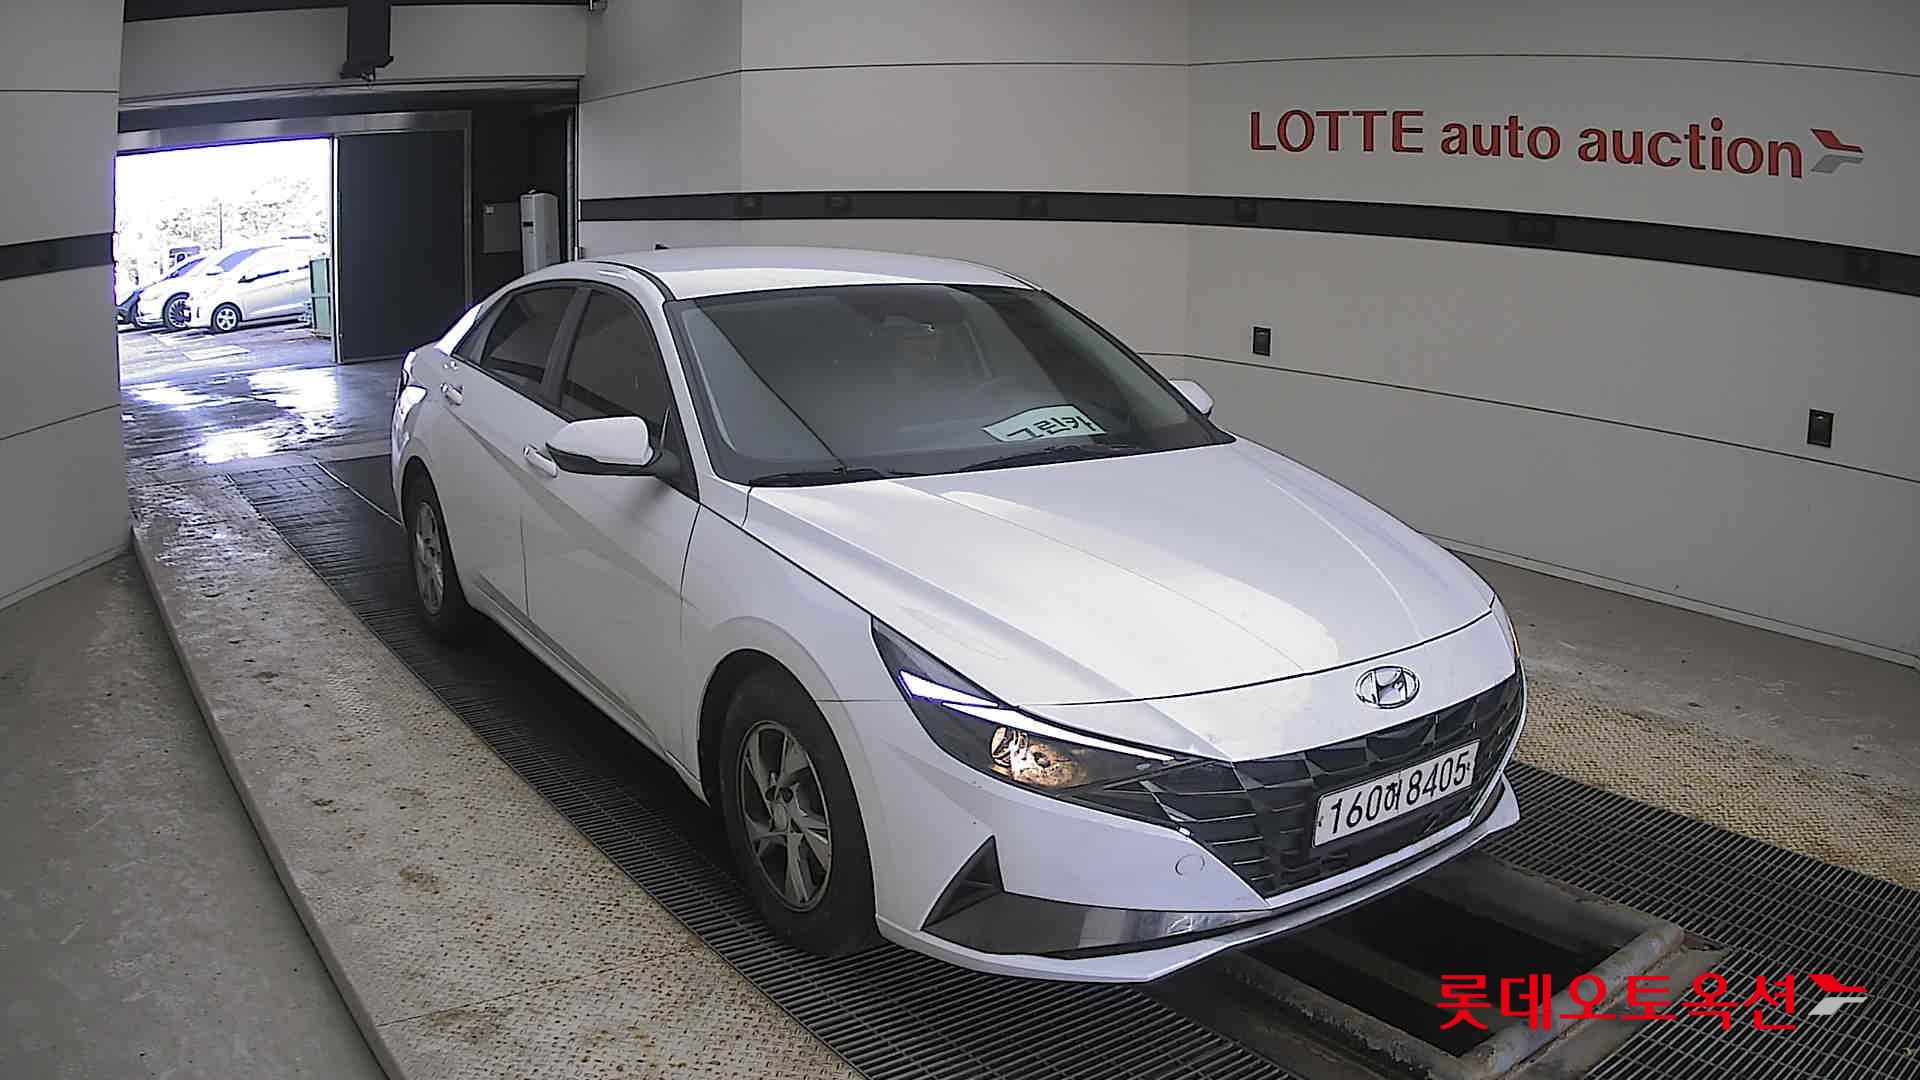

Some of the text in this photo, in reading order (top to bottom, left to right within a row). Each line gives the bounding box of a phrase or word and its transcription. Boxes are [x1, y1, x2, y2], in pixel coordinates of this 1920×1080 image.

[1250, 109, 1803, 178] LOTTE auto auction
[1006, 415, 1098, 439] 그린카
